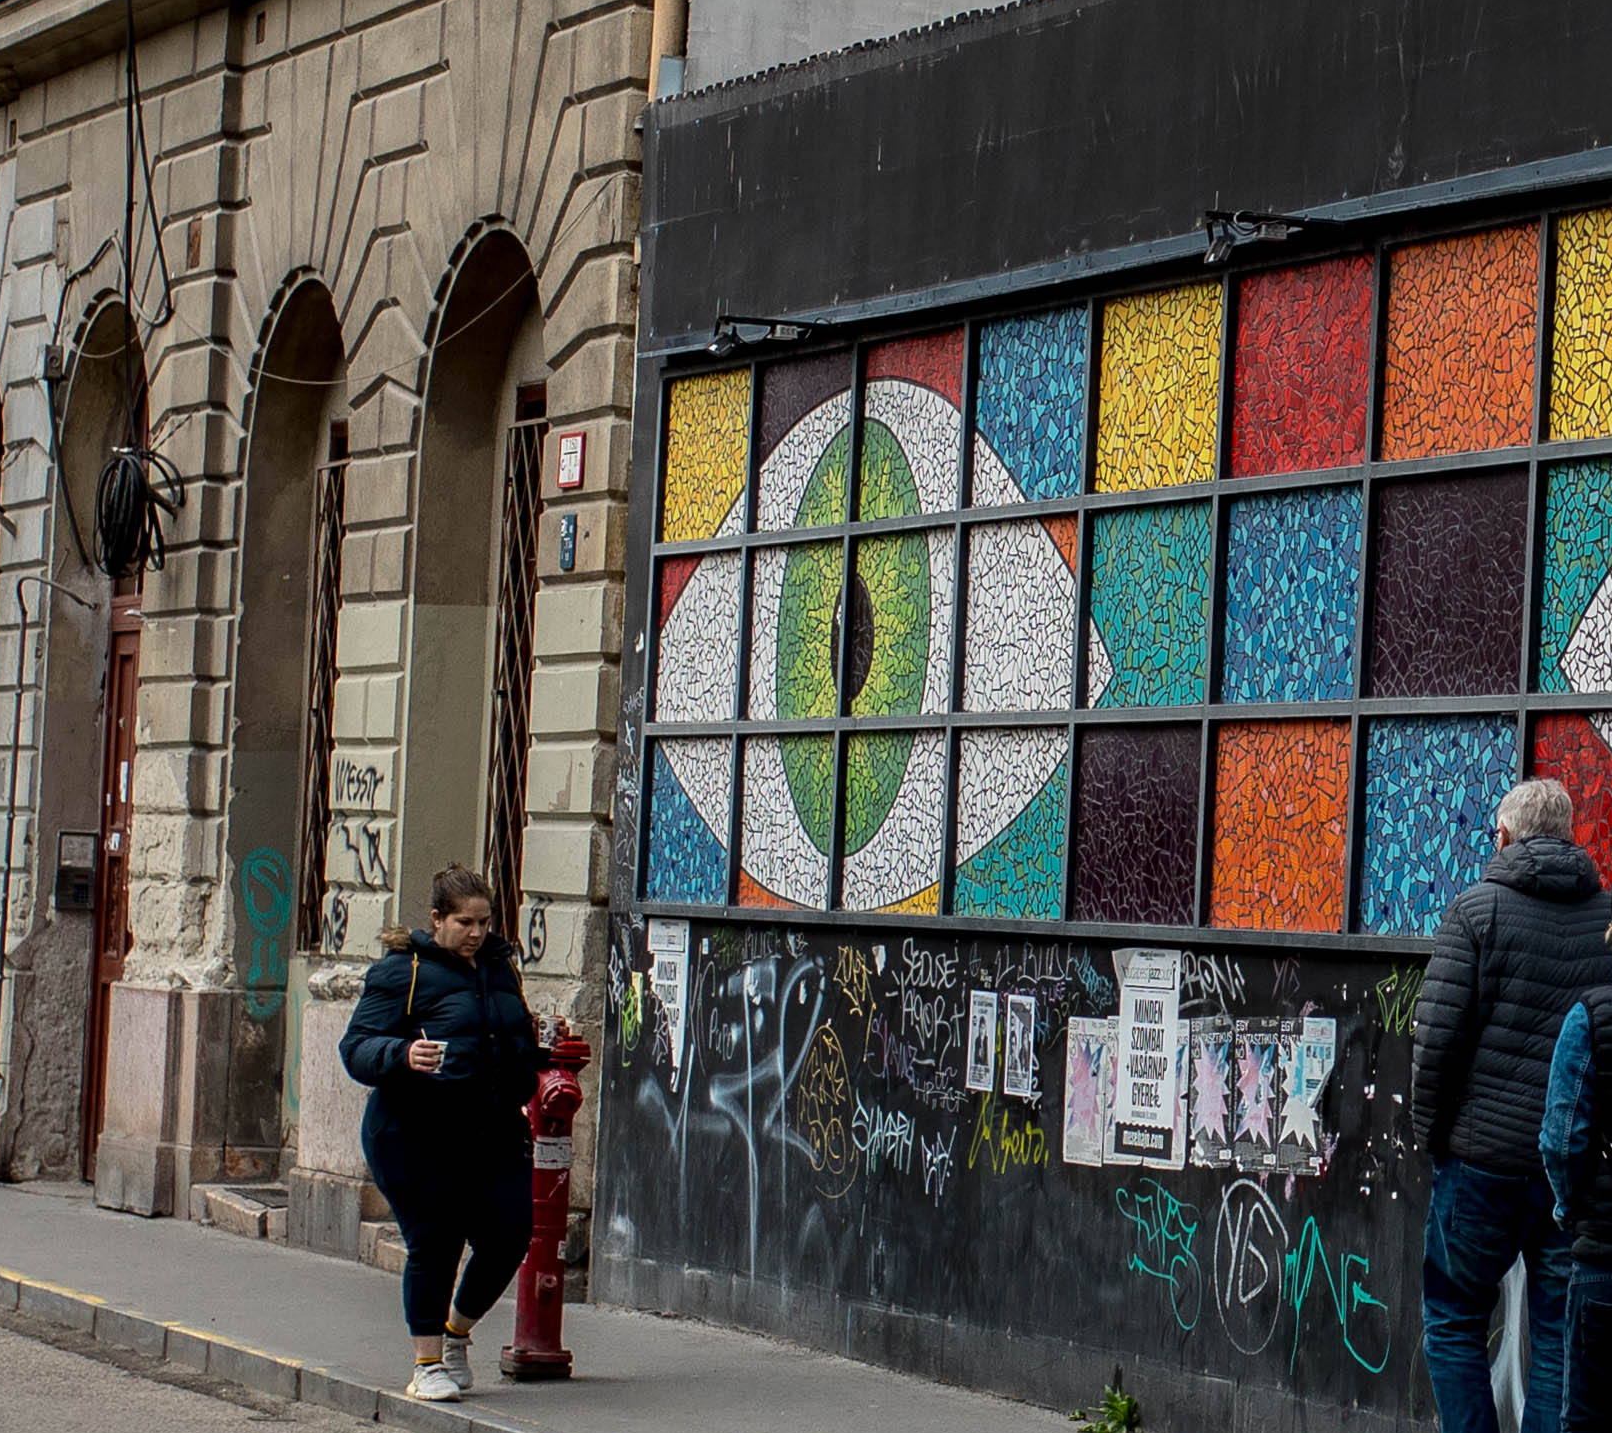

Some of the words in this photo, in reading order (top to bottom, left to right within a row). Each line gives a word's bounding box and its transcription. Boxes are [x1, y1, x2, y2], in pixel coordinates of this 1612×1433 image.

[1134, 998, 1164, 1025] MINDEN
[1236, 1020, 1249, 1031] EGY
[1281, 1021, 1294, 1032] EGY
[1131, 1026, 1165, 1054] SZOMBAT
